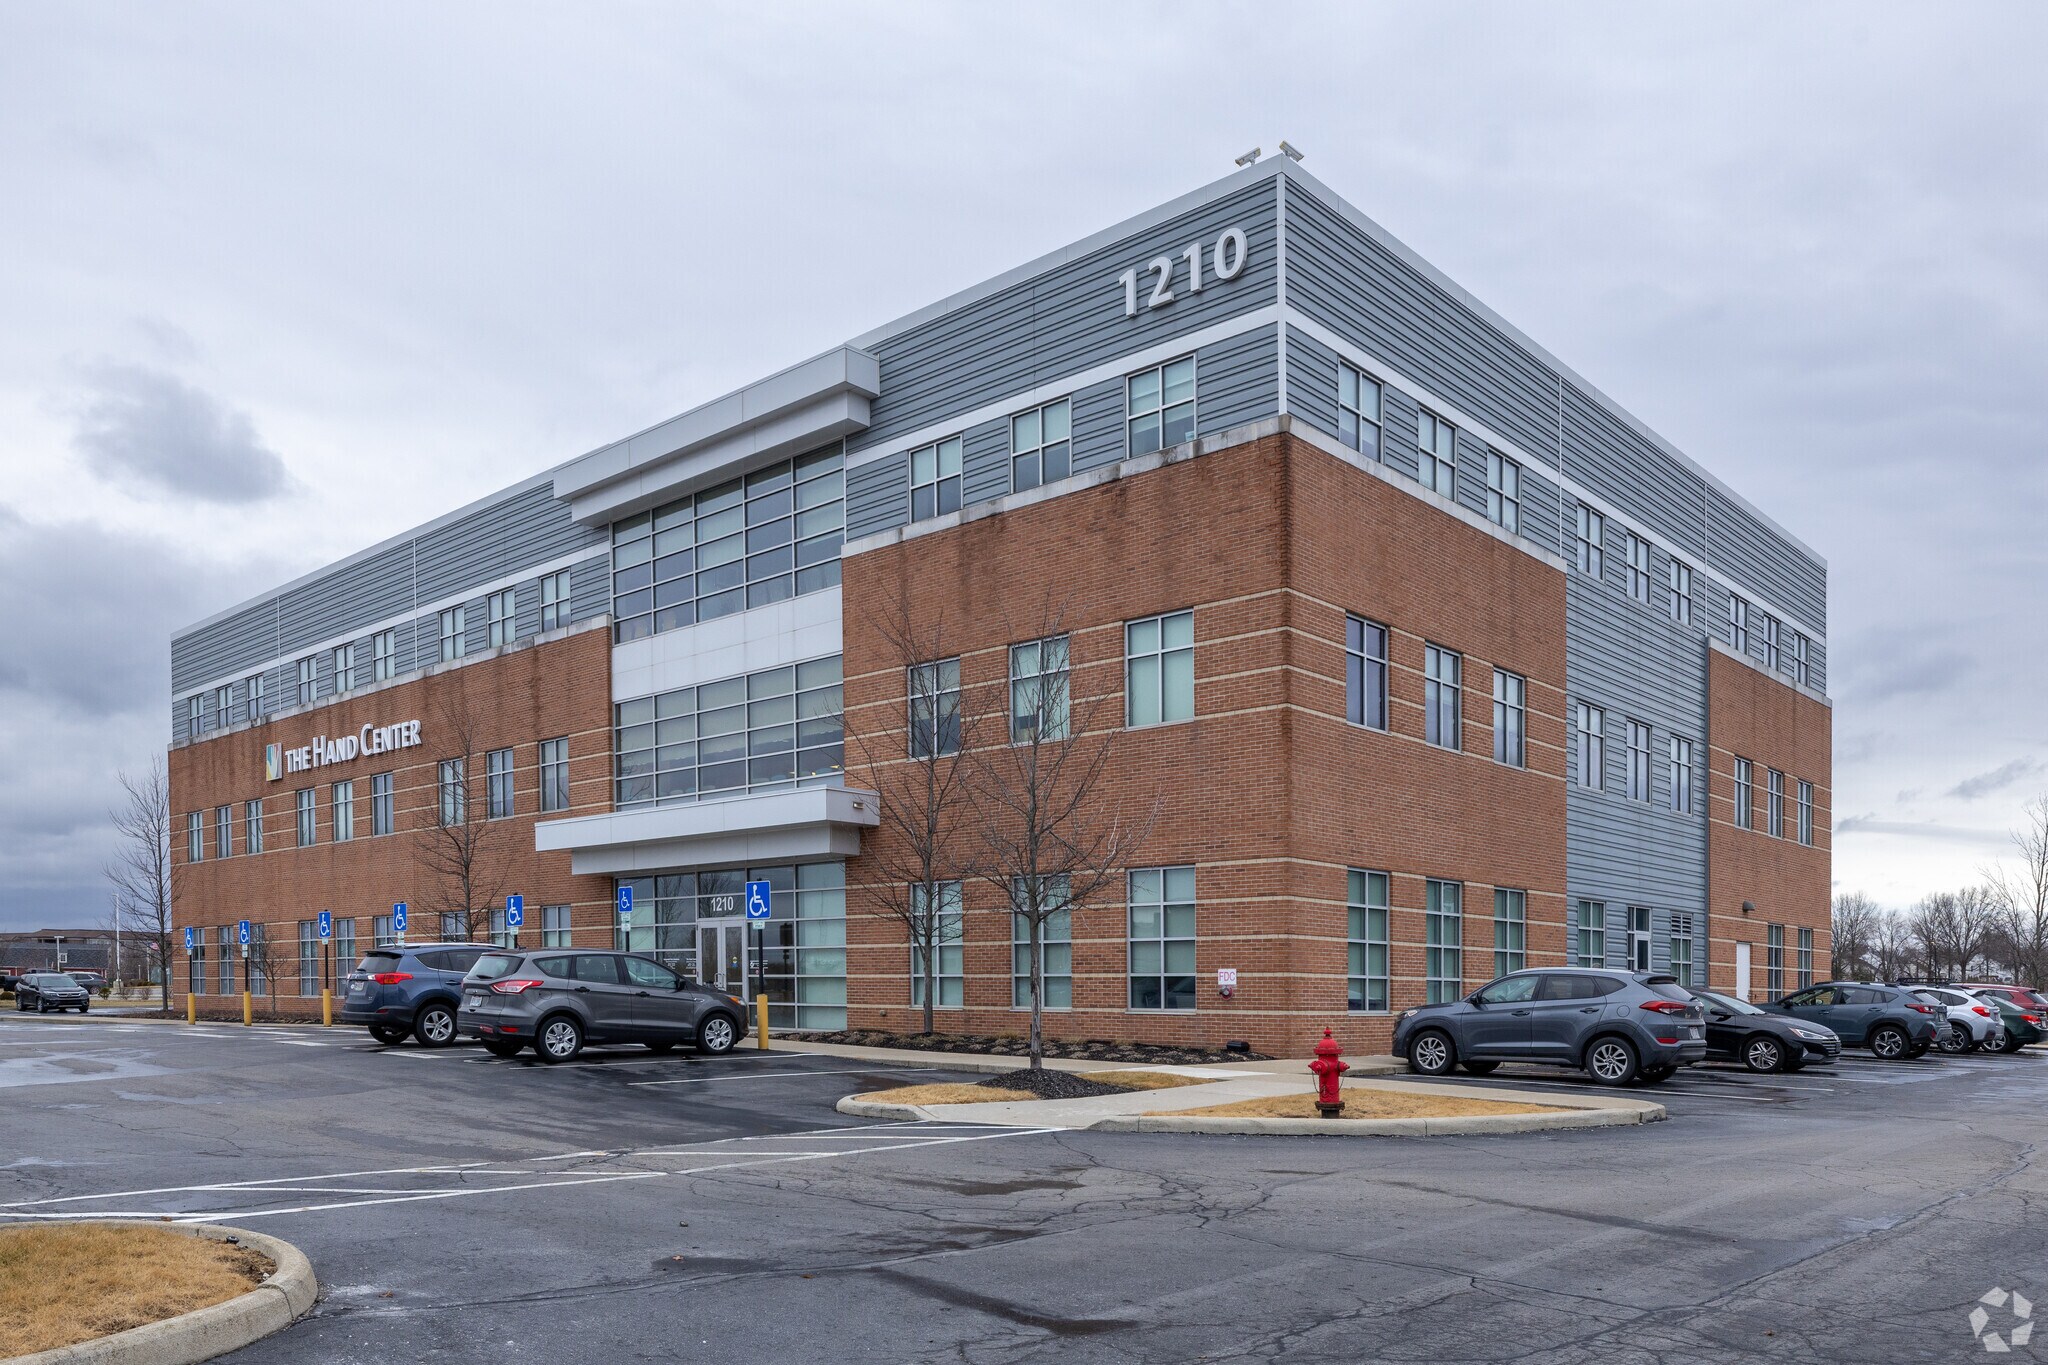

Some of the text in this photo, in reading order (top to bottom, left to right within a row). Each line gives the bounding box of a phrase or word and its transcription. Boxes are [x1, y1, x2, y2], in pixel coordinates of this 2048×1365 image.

[1118, 227, 1248, 318] 1210
[285, 746, 312, 773] THE
[710, 896, 734, 912] 1210
[1219, 971, 1236, 982] FDC
